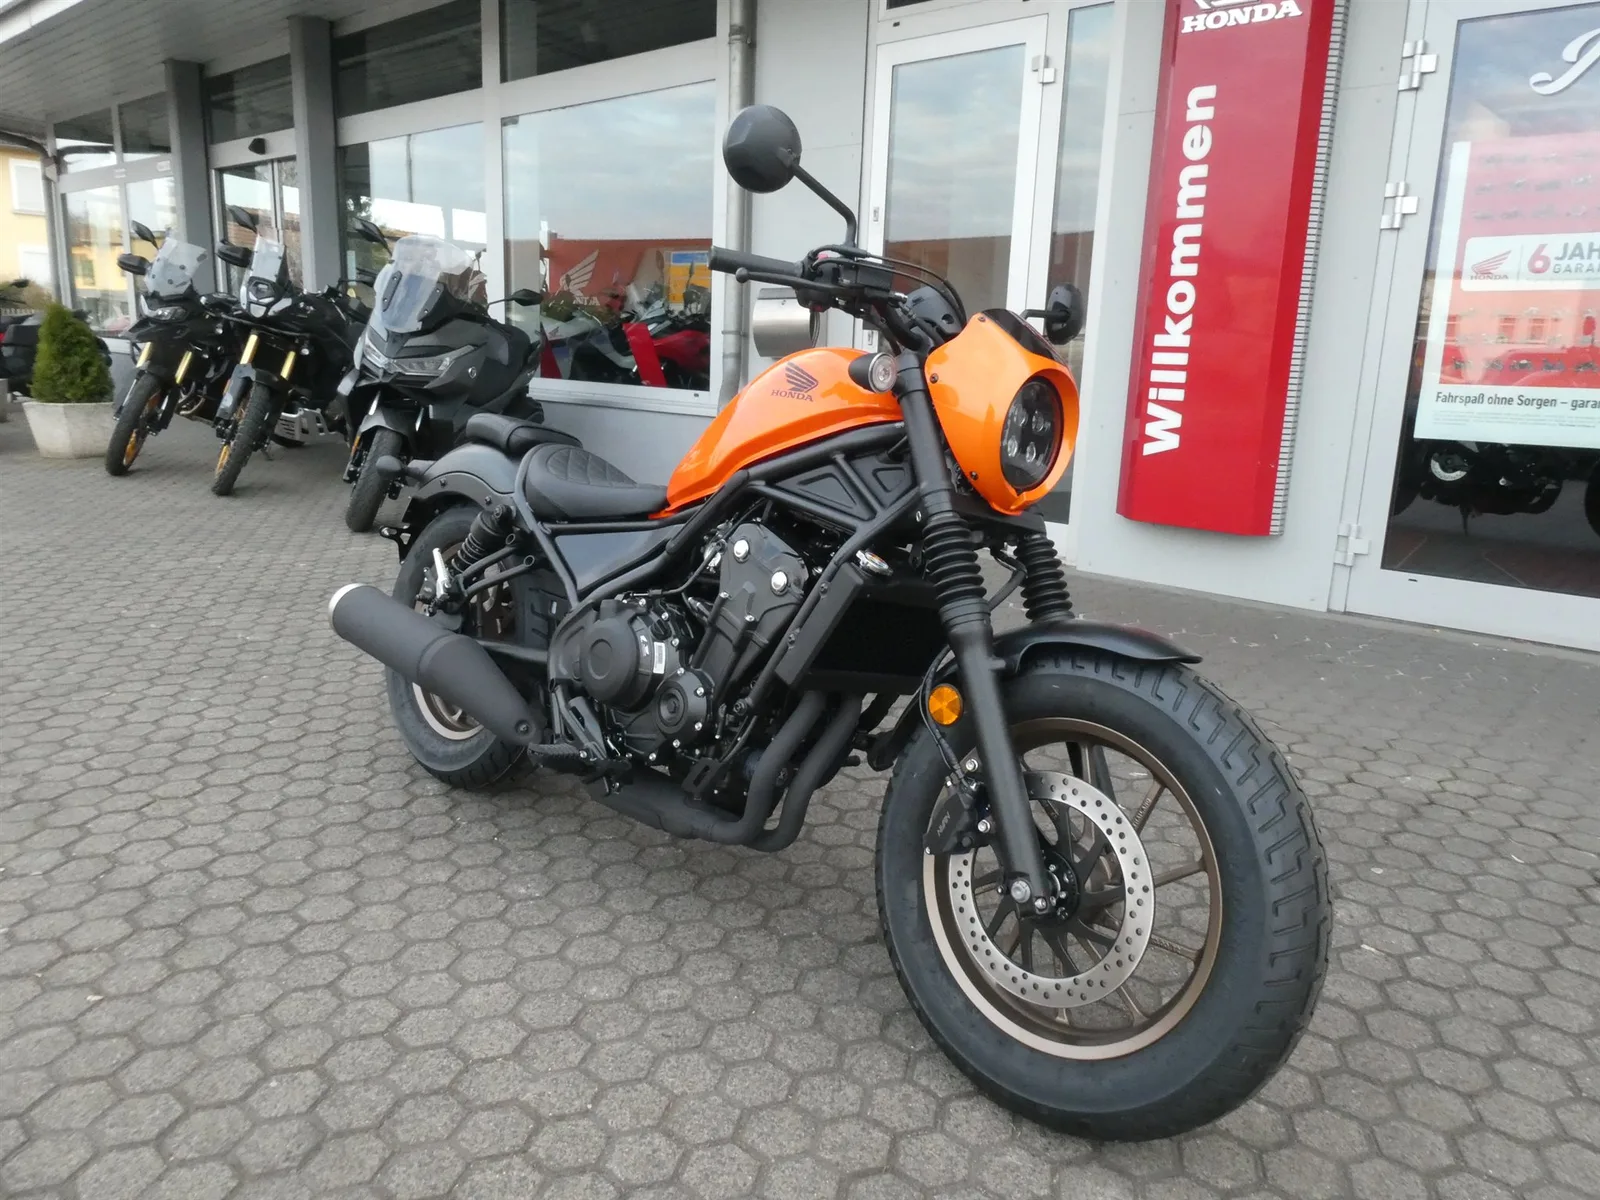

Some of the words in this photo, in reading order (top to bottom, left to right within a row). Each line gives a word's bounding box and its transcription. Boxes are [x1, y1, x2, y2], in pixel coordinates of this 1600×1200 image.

[1181, 0, 1303, 33] HONDA
[1142, 84, 1217, 456] Willkommen
[1527, 243, 1551, 275] 6
[1470, 273, 1509, 281] HONDA
[770, 389, 814, 403] HONDA
[1435, 391, 1485, 407] Fahrspaß
[1487, 393, 1514, 406] ohne
[1517, 394, 1557, 410] Sorgen
